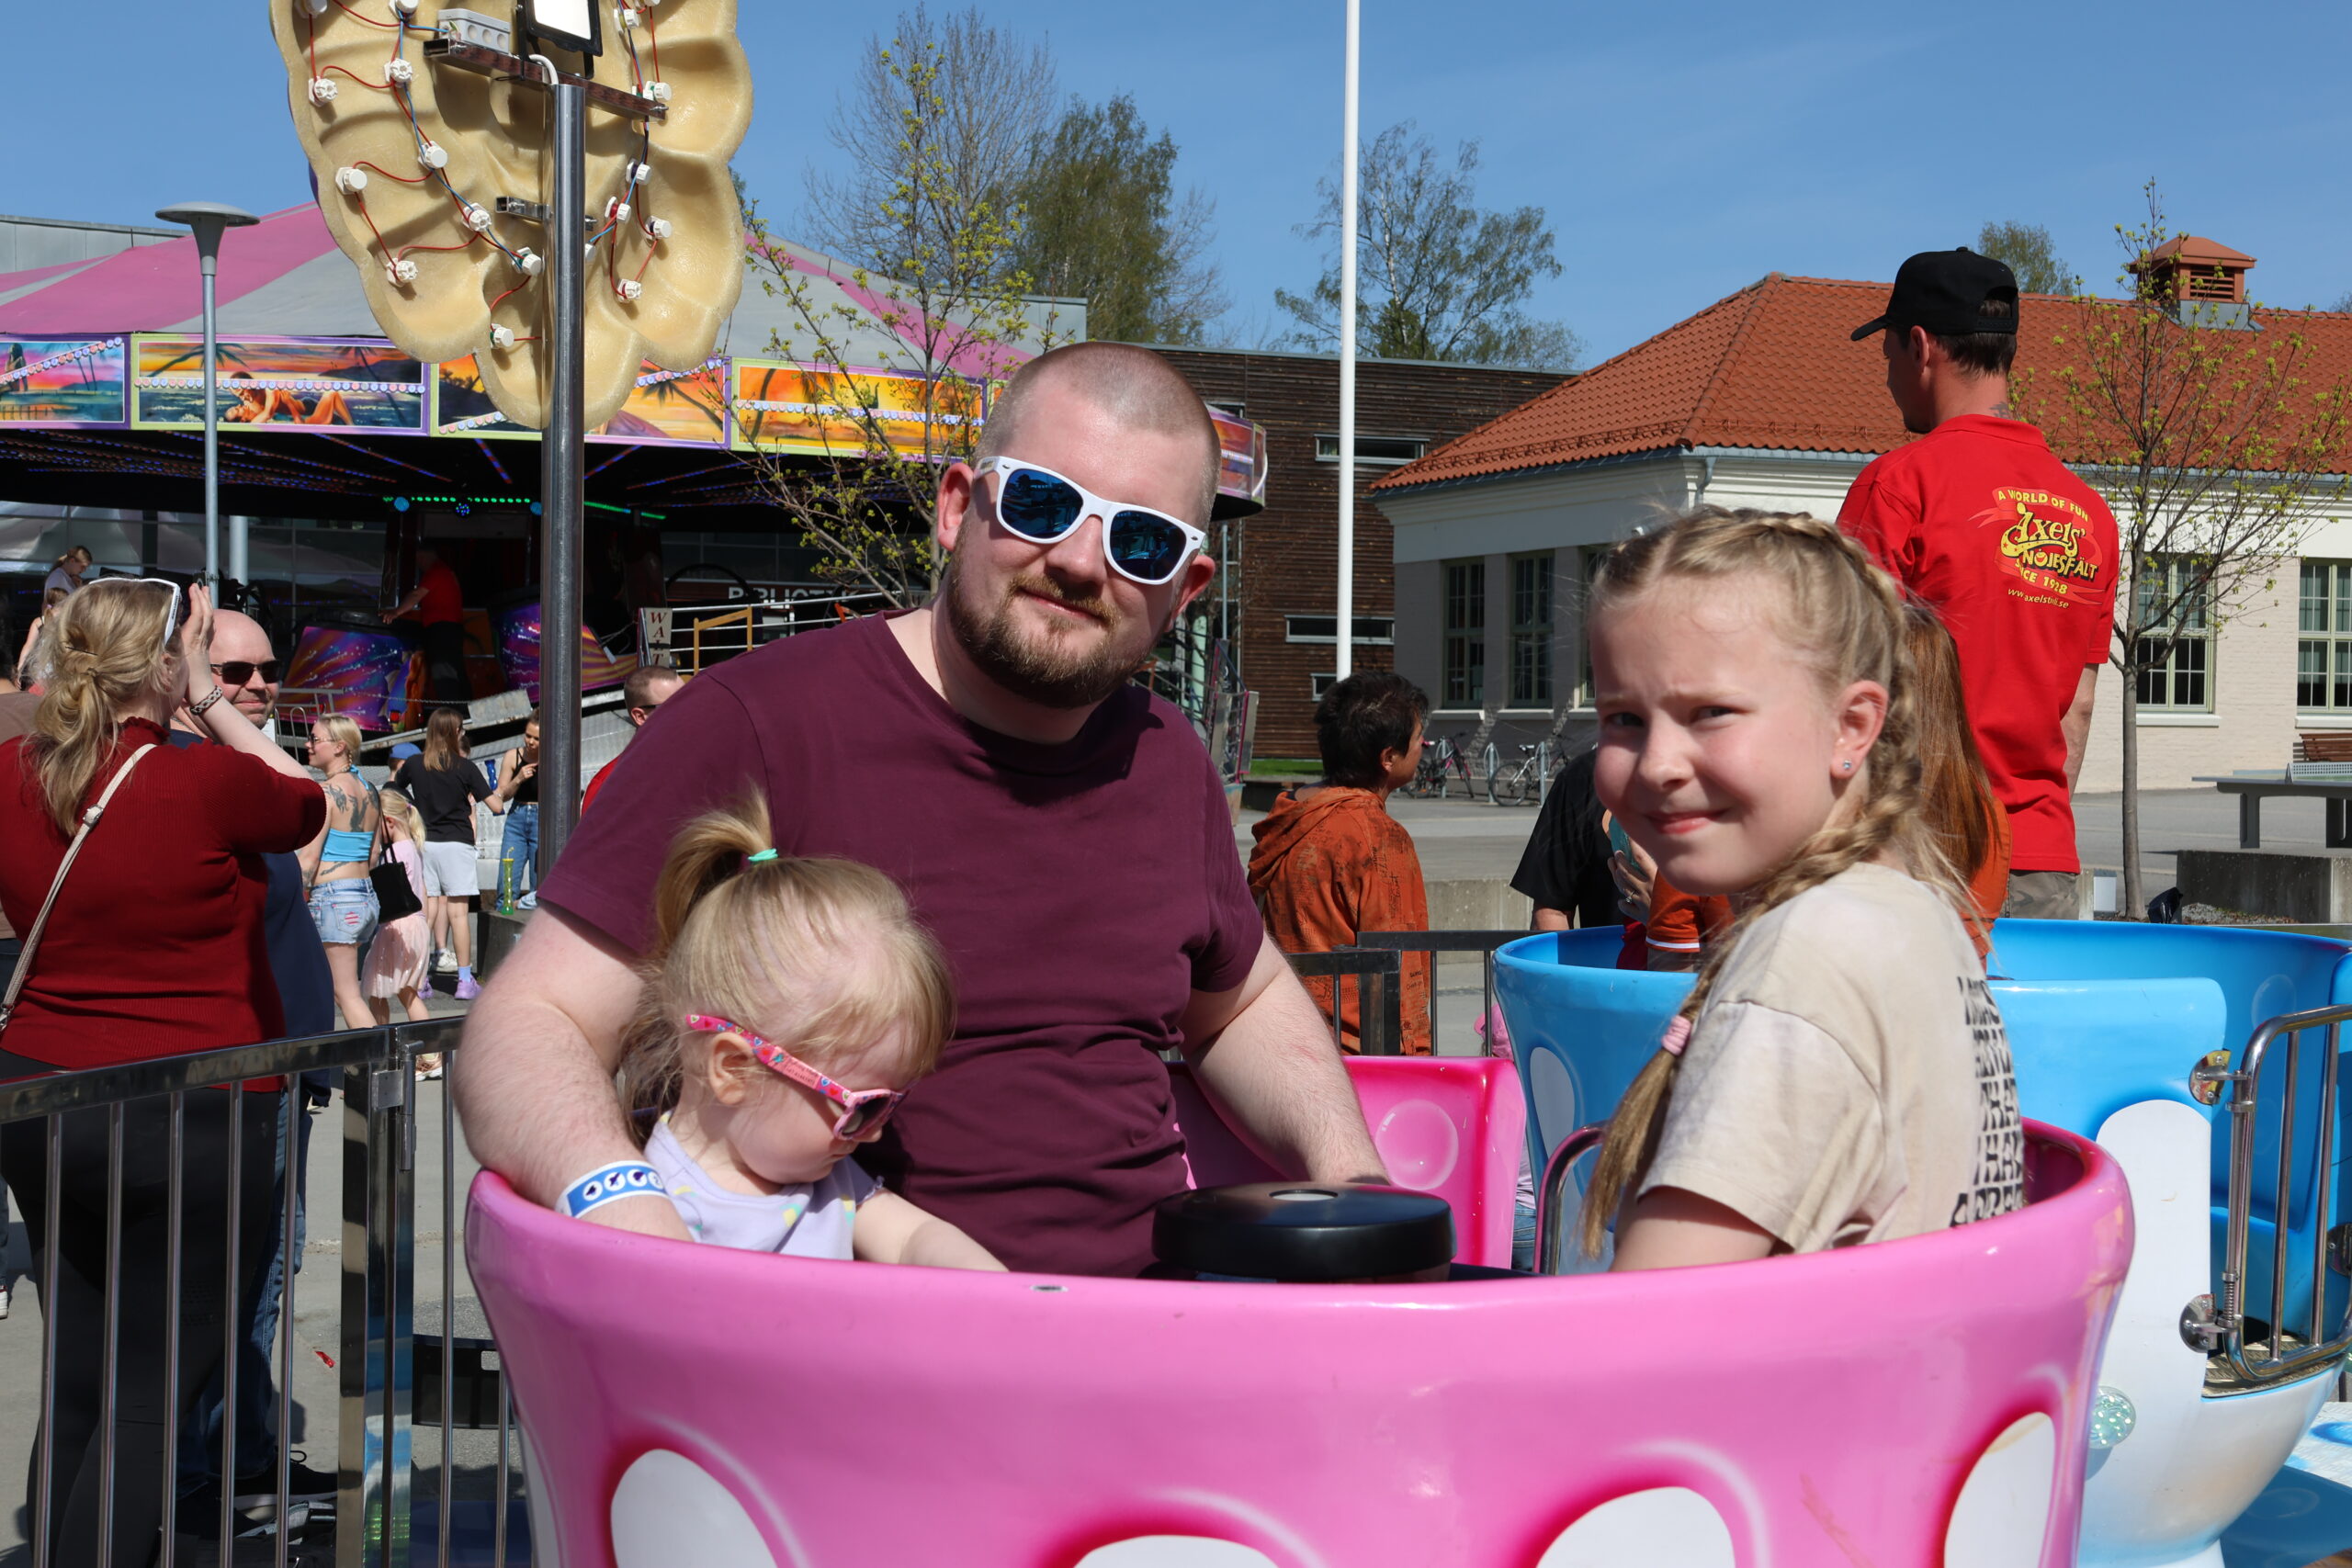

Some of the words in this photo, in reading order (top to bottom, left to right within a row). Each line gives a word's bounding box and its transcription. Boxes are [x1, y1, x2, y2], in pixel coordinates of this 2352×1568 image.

[1998, 491, 2007, 501] A
[2007, 490, 2049, 503] WORLD
[2051, 497, 2065, 509] OF
[2069, 502, 2088, 523] FUN
[2015, 558, 2038, 583] SCE
[2043, 576, 2068, 594] 1928
